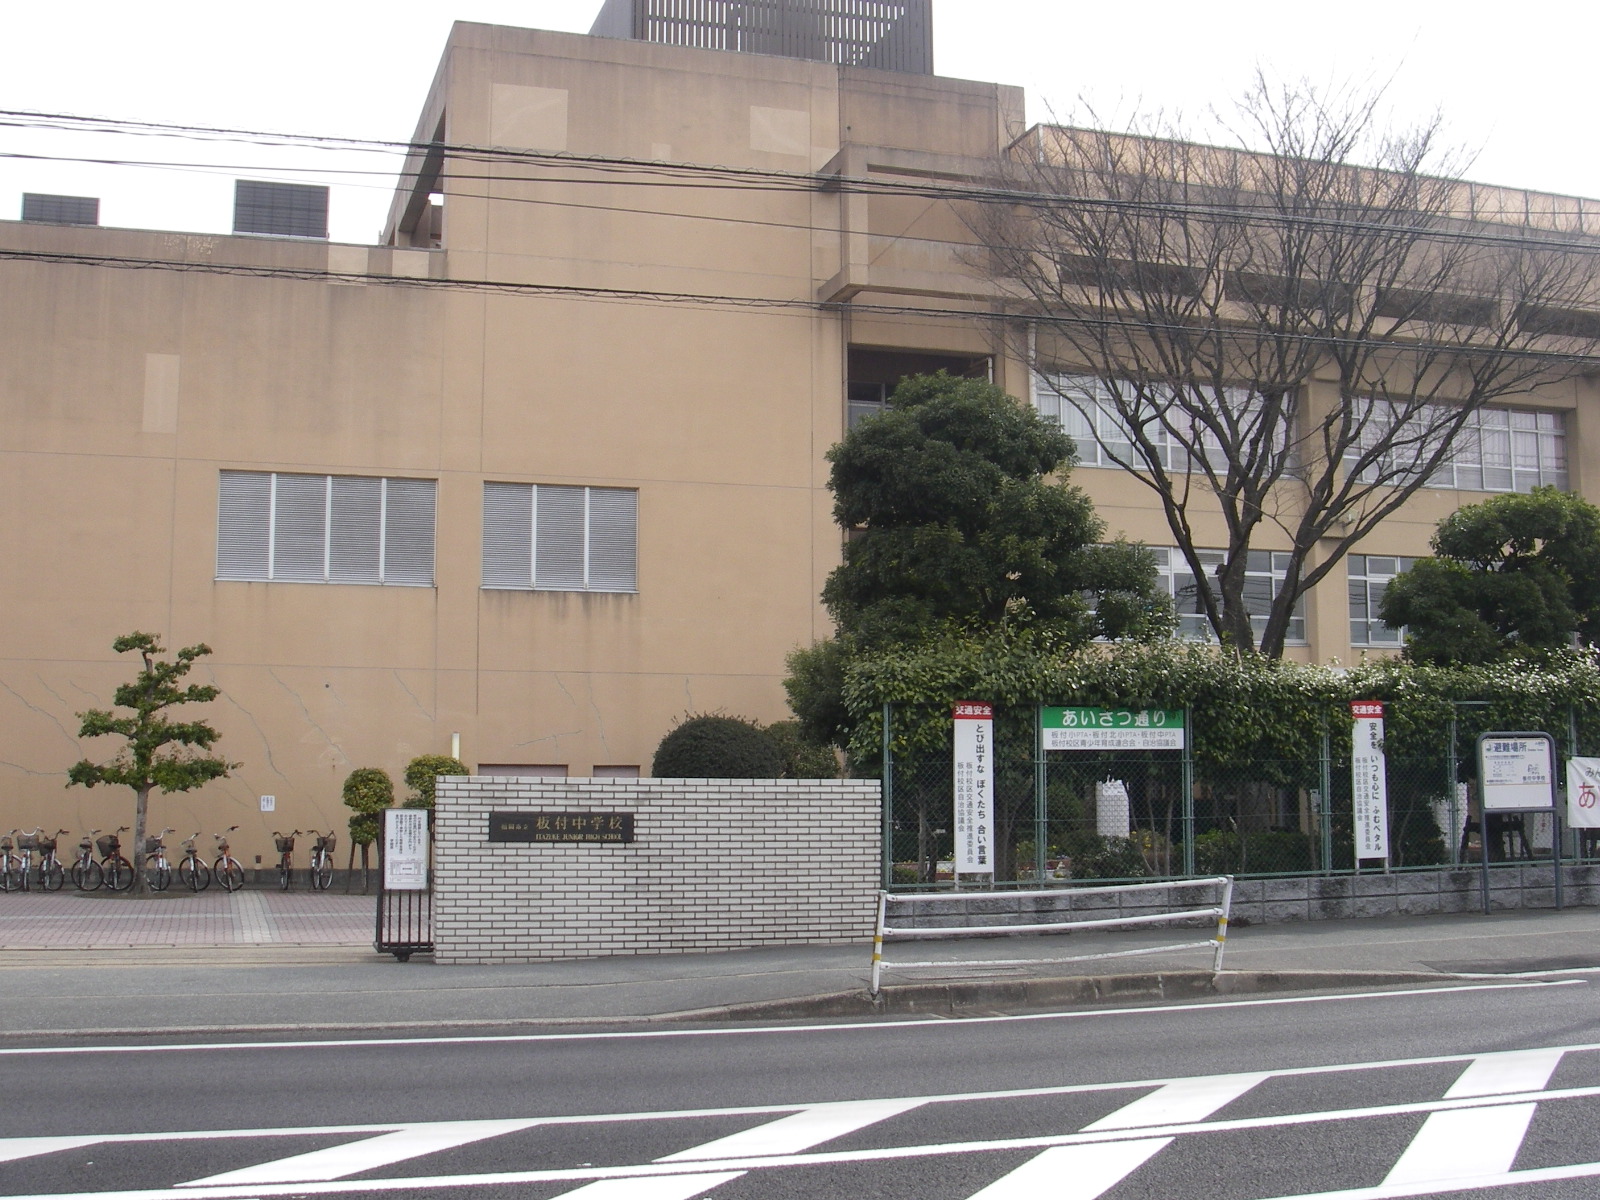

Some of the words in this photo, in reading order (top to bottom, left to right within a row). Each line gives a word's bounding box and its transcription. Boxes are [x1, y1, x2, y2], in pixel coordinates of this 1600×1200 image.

[955, 705, 992, 716] 交通安全
[1062, 709, 1166, 727] あいさつ通り
[1351, 704, 1383, 715] 交通安全
[975, 723, 986, 774] とび出すな
[1494, 742, 1527, 752] 避難場所
[1370, 755, 1381, 801] いつも心に
[976, 779, 987, 820] ぼくたち
[536, 816, 623, 830] 板付中学校
[976, 824, 987, 866] 合い言葉
